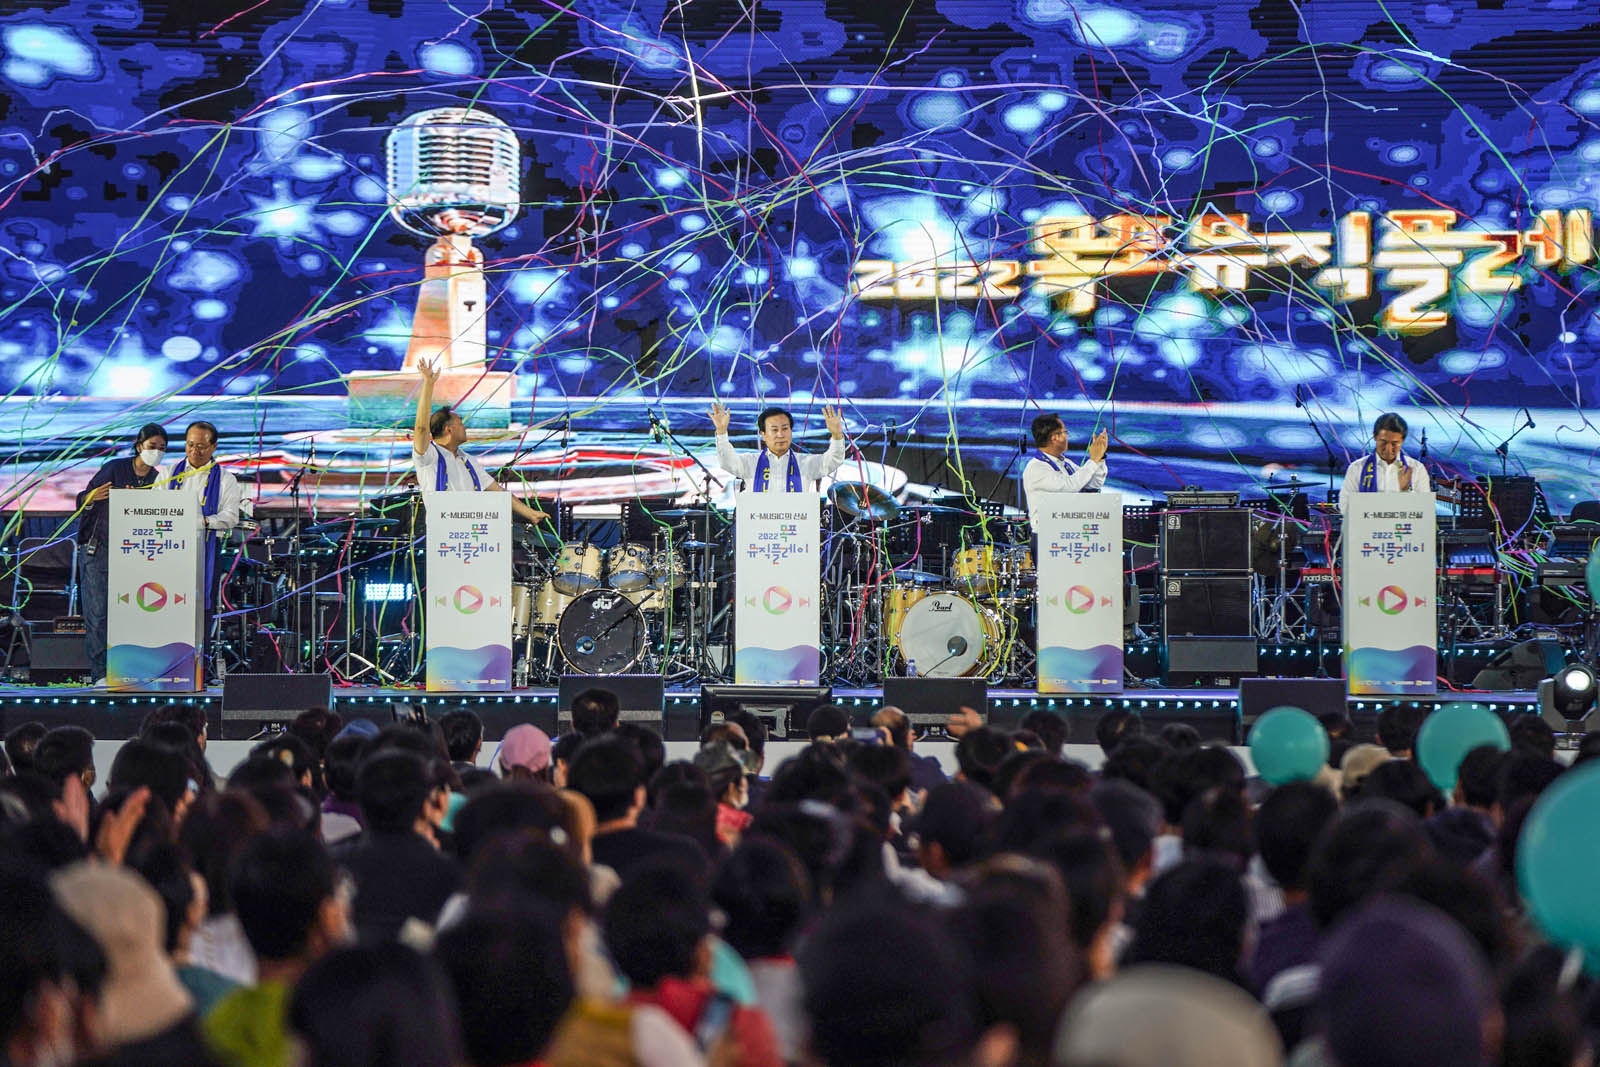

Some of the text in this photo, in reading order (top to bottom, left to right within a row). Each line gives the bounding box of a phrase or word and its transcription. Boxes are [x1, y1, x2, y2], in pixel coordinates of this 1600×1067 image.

[853, 260, 1021, 299] 2022
[124, 508, 168, 516] K-MUSIC의
[155, 521, 173, 539] 목포
[471, 524, 488, 542] 목포
[780, 524, 797, 542] 목포
[1082, 524, 1099, 542] 목포
[1394, 524, 1412, 542] 목포
[121, 539, 184, 560] 뮤직플레이
[438, 542, 500, 564] 뮤직플레이
[747, 544, 808, 565] 뮤직플레이
[1049, 542, 1111, 564] 뮤직플레이
[1361, 542, 1424, 564] 뮤직플레이
[932, 600, 952, 611] Pearl
